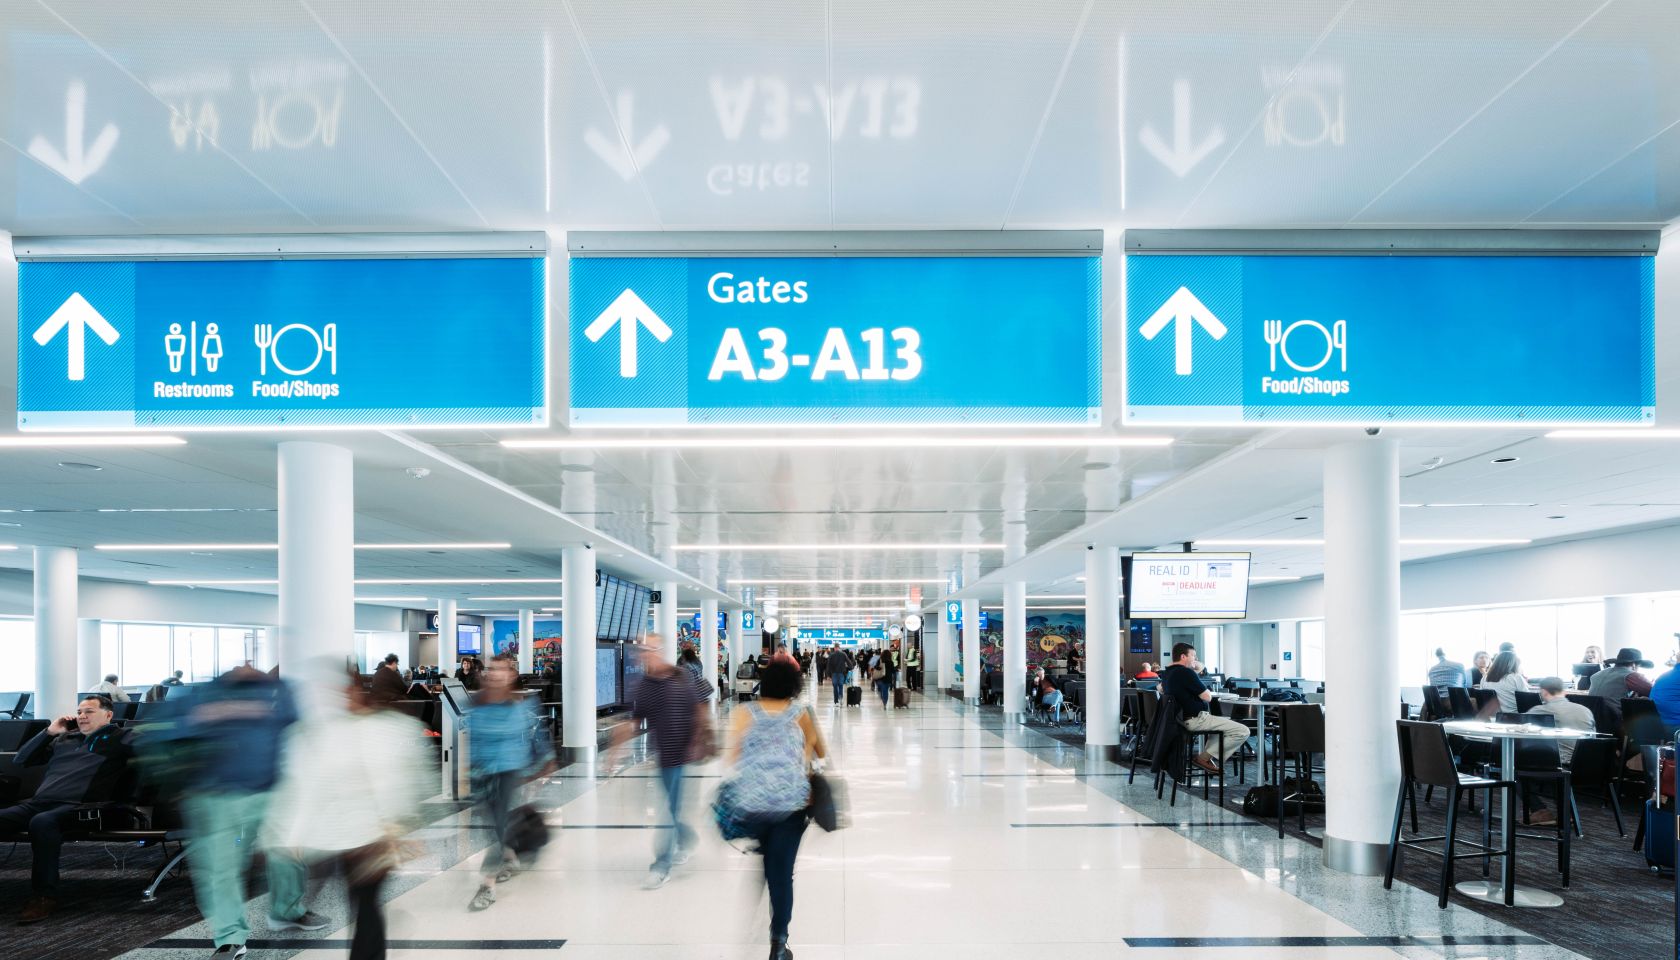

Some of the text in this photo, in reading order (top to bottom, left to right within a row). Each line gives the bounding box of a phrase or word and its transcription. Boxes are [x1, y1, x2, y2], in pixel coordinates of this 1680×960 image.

[707, 272, 808, 304] Gates
[707, 327, 923, 381] A3-A13
[154, 381, 234, 398] Restrooms
[252, 380, 340, 400] Food/Shops
[1262, 376, 1350, 396] Food/Shops
[1149, 565, 1190, 576] REAL ID
[1179, 581, 1217, 590] DEADLINE
[951, 613, 957, 621] 3
